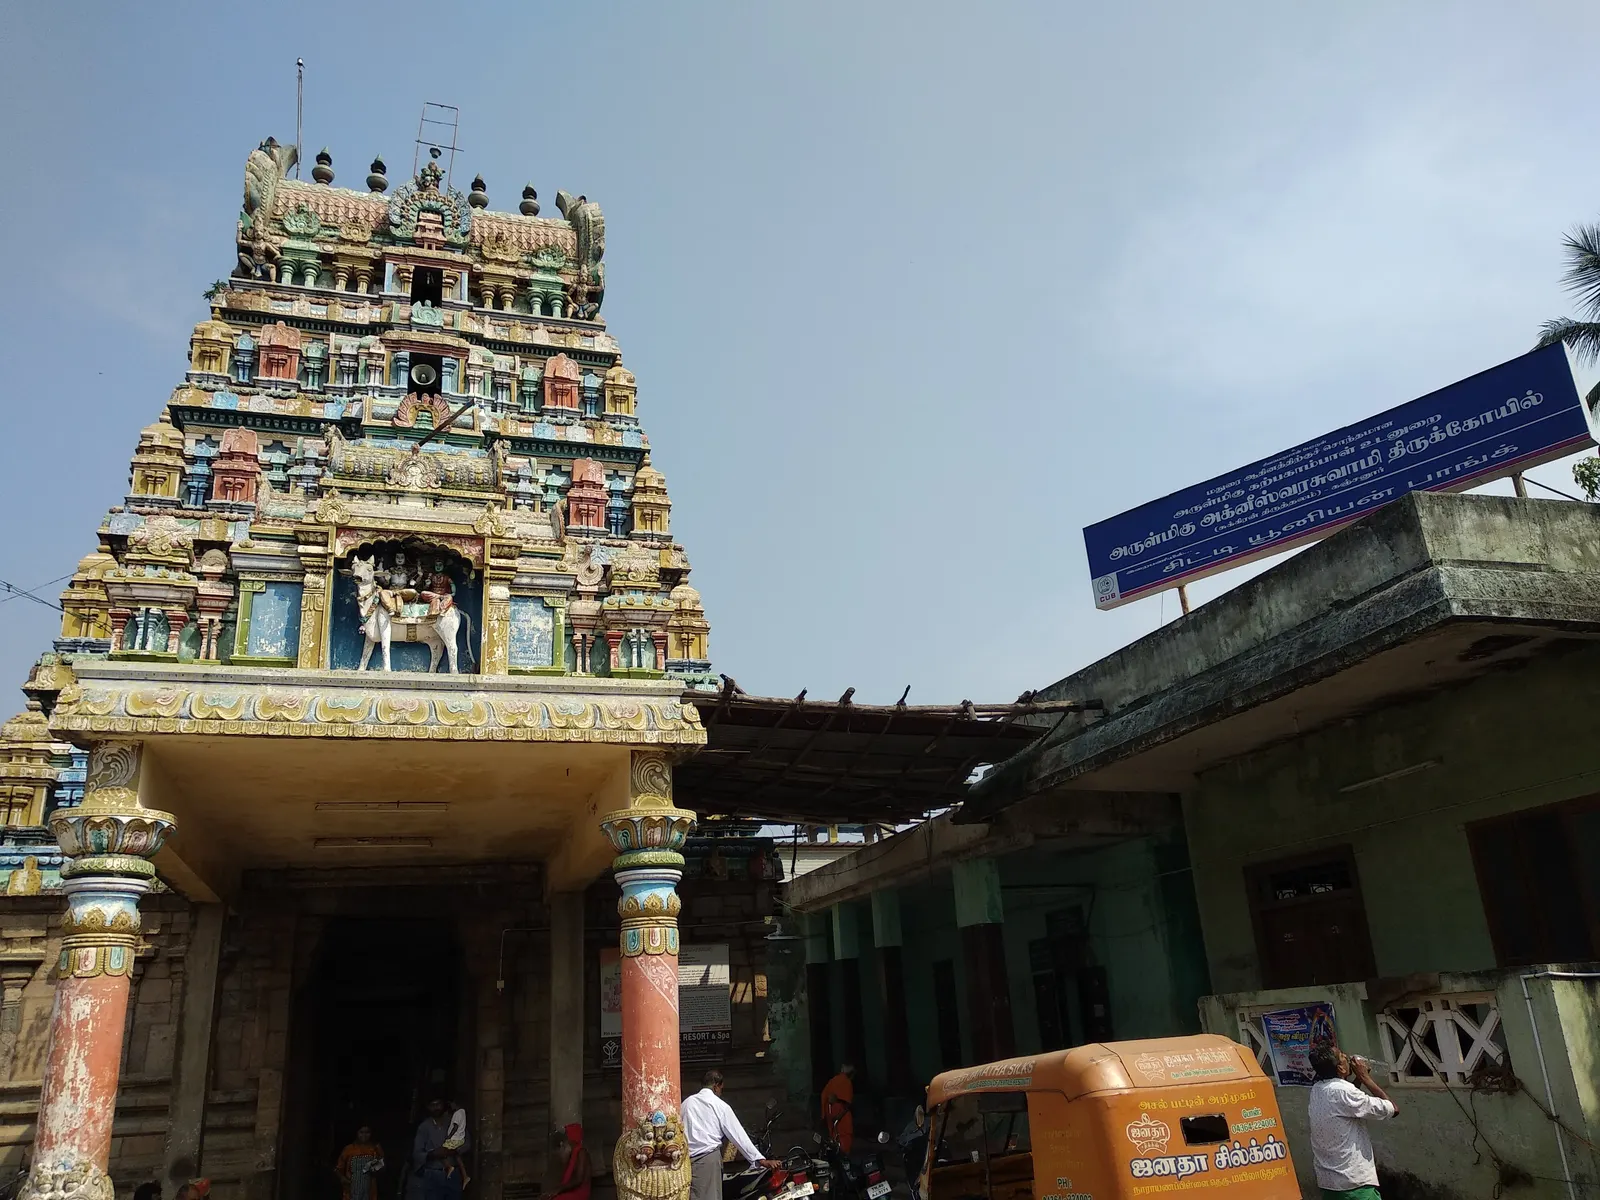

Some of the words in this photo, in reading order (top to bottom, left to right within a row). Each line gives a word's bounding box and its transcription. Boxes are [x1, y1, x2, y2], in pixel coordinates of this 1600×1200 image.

[1109, 521, 1196, 561] அருள்மிகு
[1200, 448, 1383, 528] அக்னீஸ்வரசுவாமி
[1387, 389, 1544, 464] திருக்கோயில்
[1173, 487, 1246, 519] அருள்மிகு
[1248, 445, 1356, 492] கற்பகாம்பாள்
[1360, 414, 1442, 450] உடனுறை
[1206, 478, 1242, 496] மதுரை
[1323, 420, 1394, 452] சொந்தமான
[1162, 545, 1239, 573] சிட்டி
[1248, 487, 1395, 546] யூனியன்
[1407, 443, 1519, 489] பாங்க்
[1099, 592, 1117, 603] CUB
[682, 1032, 710, 1041] RESORT
[717, 1031, 730, 1041] Spa
[1007, 1060, 1036, 1076] SILKS
[1138, 1097, 1169, 1111] அசல்
[1207, 1088, 1257, 1106] அறிமுகம்
[1131, 1126, 1166, 1140] ஜனதா
[1131, 1154, 1208, 1180] ஜனதா
[1214, 1134, 1287, 1170] சில்க்ஸ்
